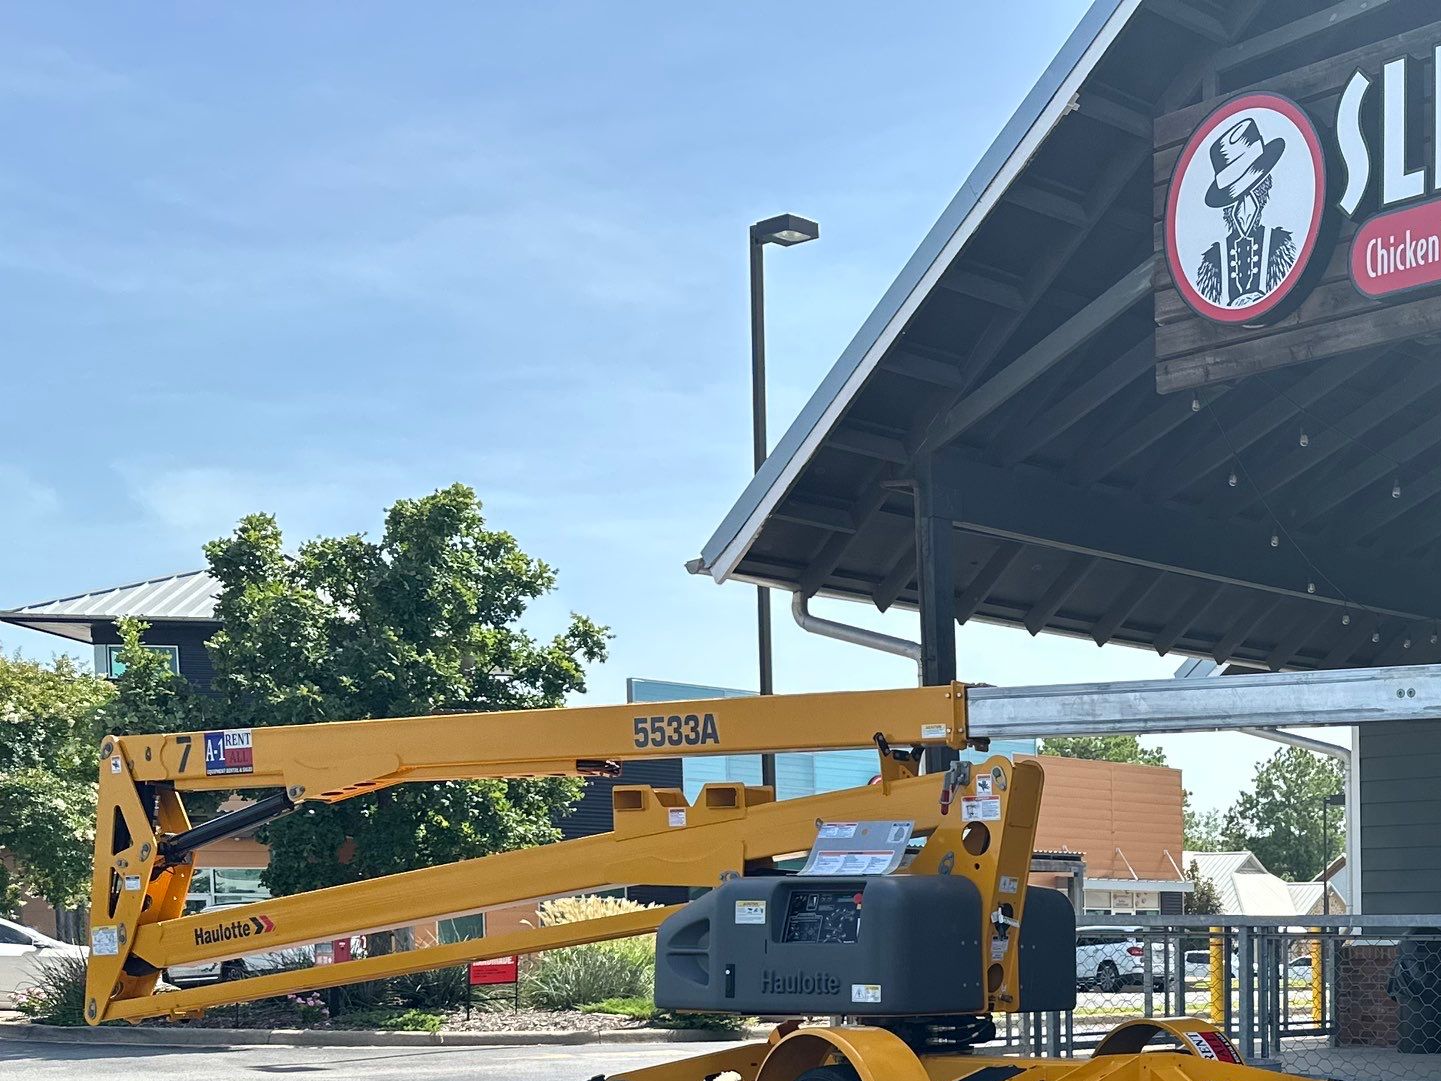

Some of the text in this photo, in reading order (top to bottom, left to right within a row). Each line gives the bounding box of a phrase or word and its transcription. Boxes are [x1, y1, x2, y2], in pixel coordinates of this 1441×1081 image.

[1365, 234, 1439, 279] Chicken
[225, 732, 251, 747] RENT
[633, 713, 720, 748] 5533A
[176, 735, 192, 773] 7
[206, 738, 226, 762] A-1
[230, 751, 249, 763] ALL
[194, 920, 251, 946] Haulotte
[761, 969, 841, 996] Haulotte
